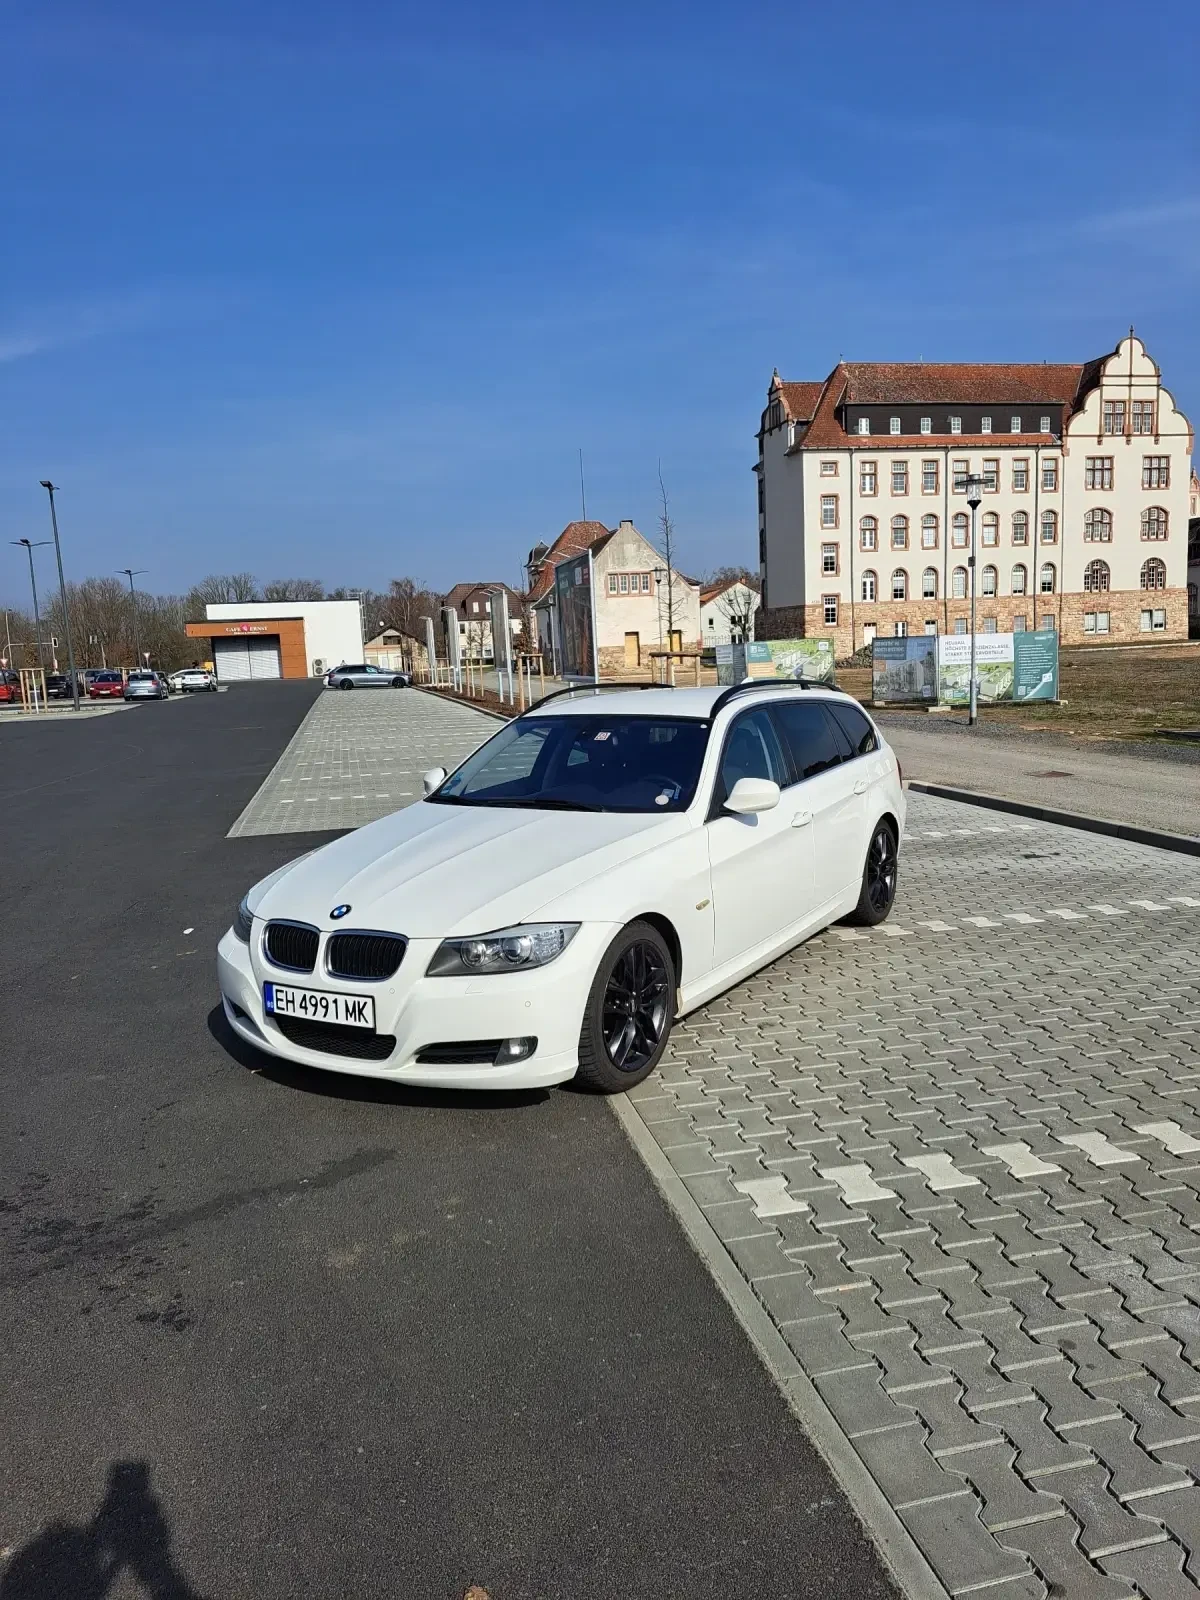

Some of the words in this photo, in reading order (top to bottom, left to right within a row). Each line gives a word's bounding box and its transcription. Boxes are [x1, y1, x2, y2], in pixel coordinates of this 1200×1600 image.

[275, 988, 296, 1013] EH
[299, 993, 339, 1020] 4991
[344, 999, 369, 1024] MK
